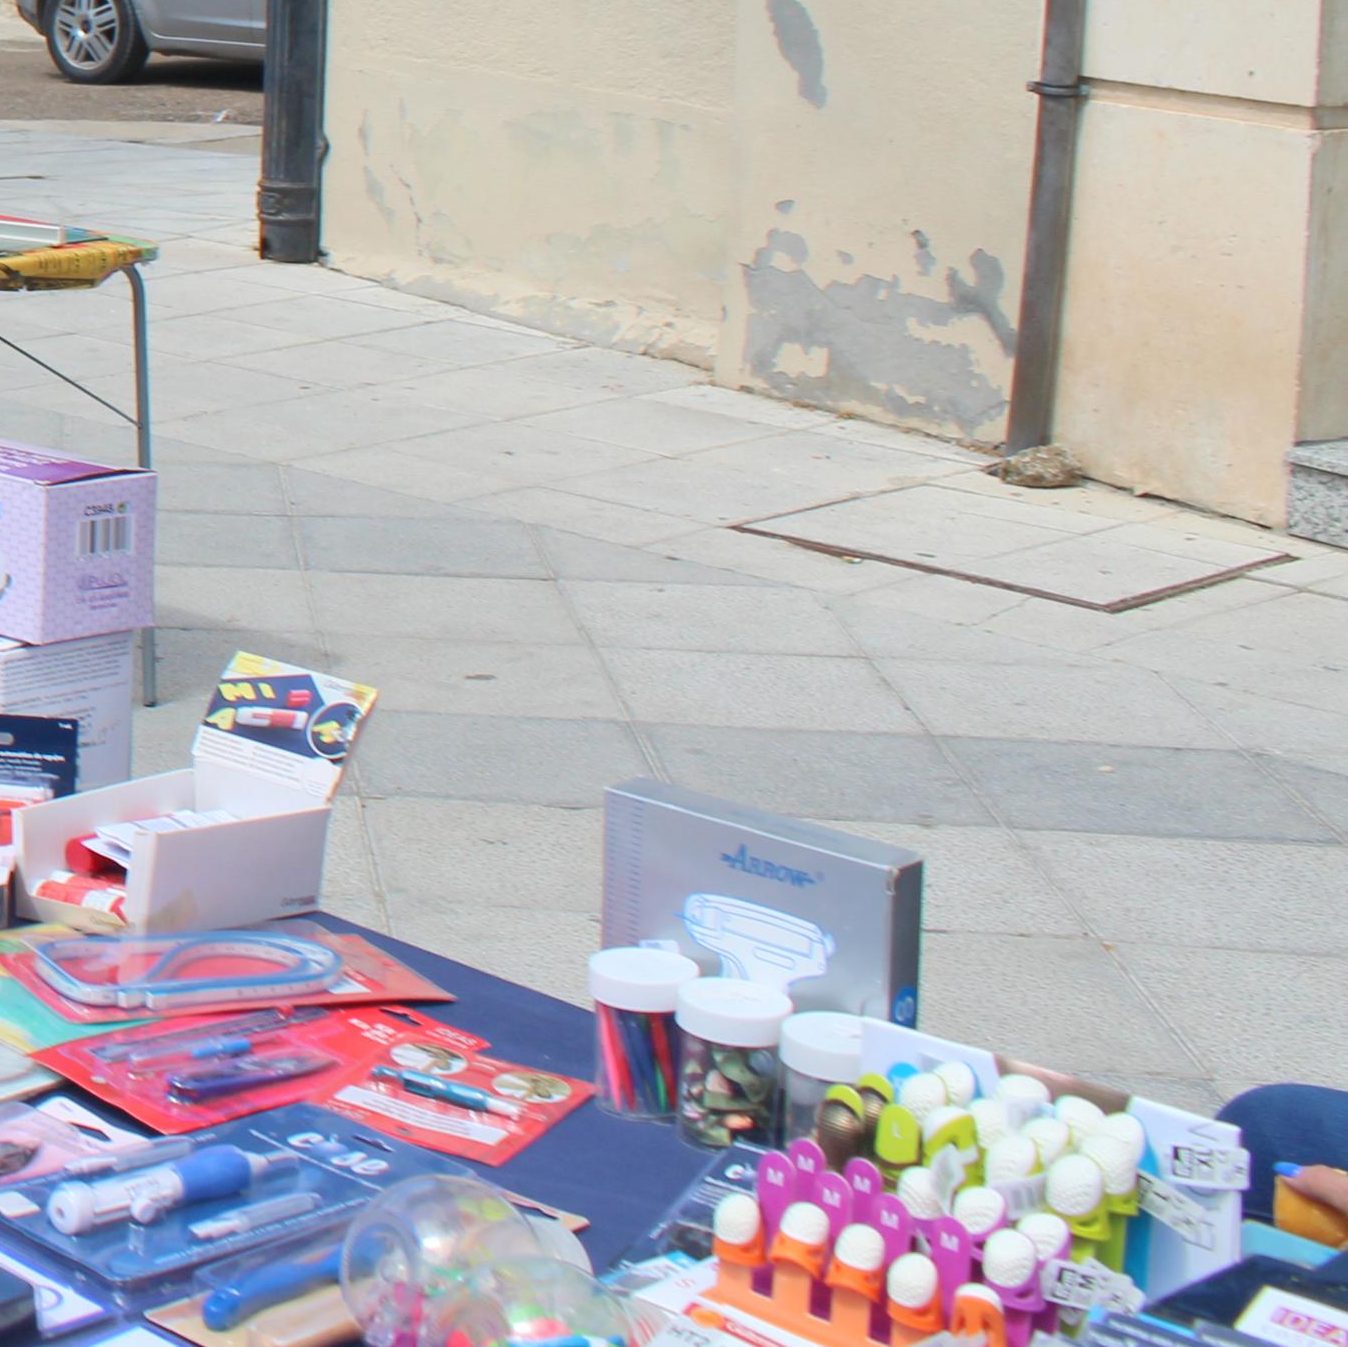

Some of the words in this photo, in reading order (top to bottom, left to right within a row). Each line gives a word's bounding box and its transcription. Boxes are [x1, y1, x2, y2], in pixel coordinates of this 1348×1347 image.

[797, 1155, 815, 1173] M
[767, 1168, 785, 1187] M
[854, 1175, 871, 1193] M
[822, 1189, 841, 1208] M
[880, 1210, 899, 1230] M
[940, 1232, 960, 1251] M
